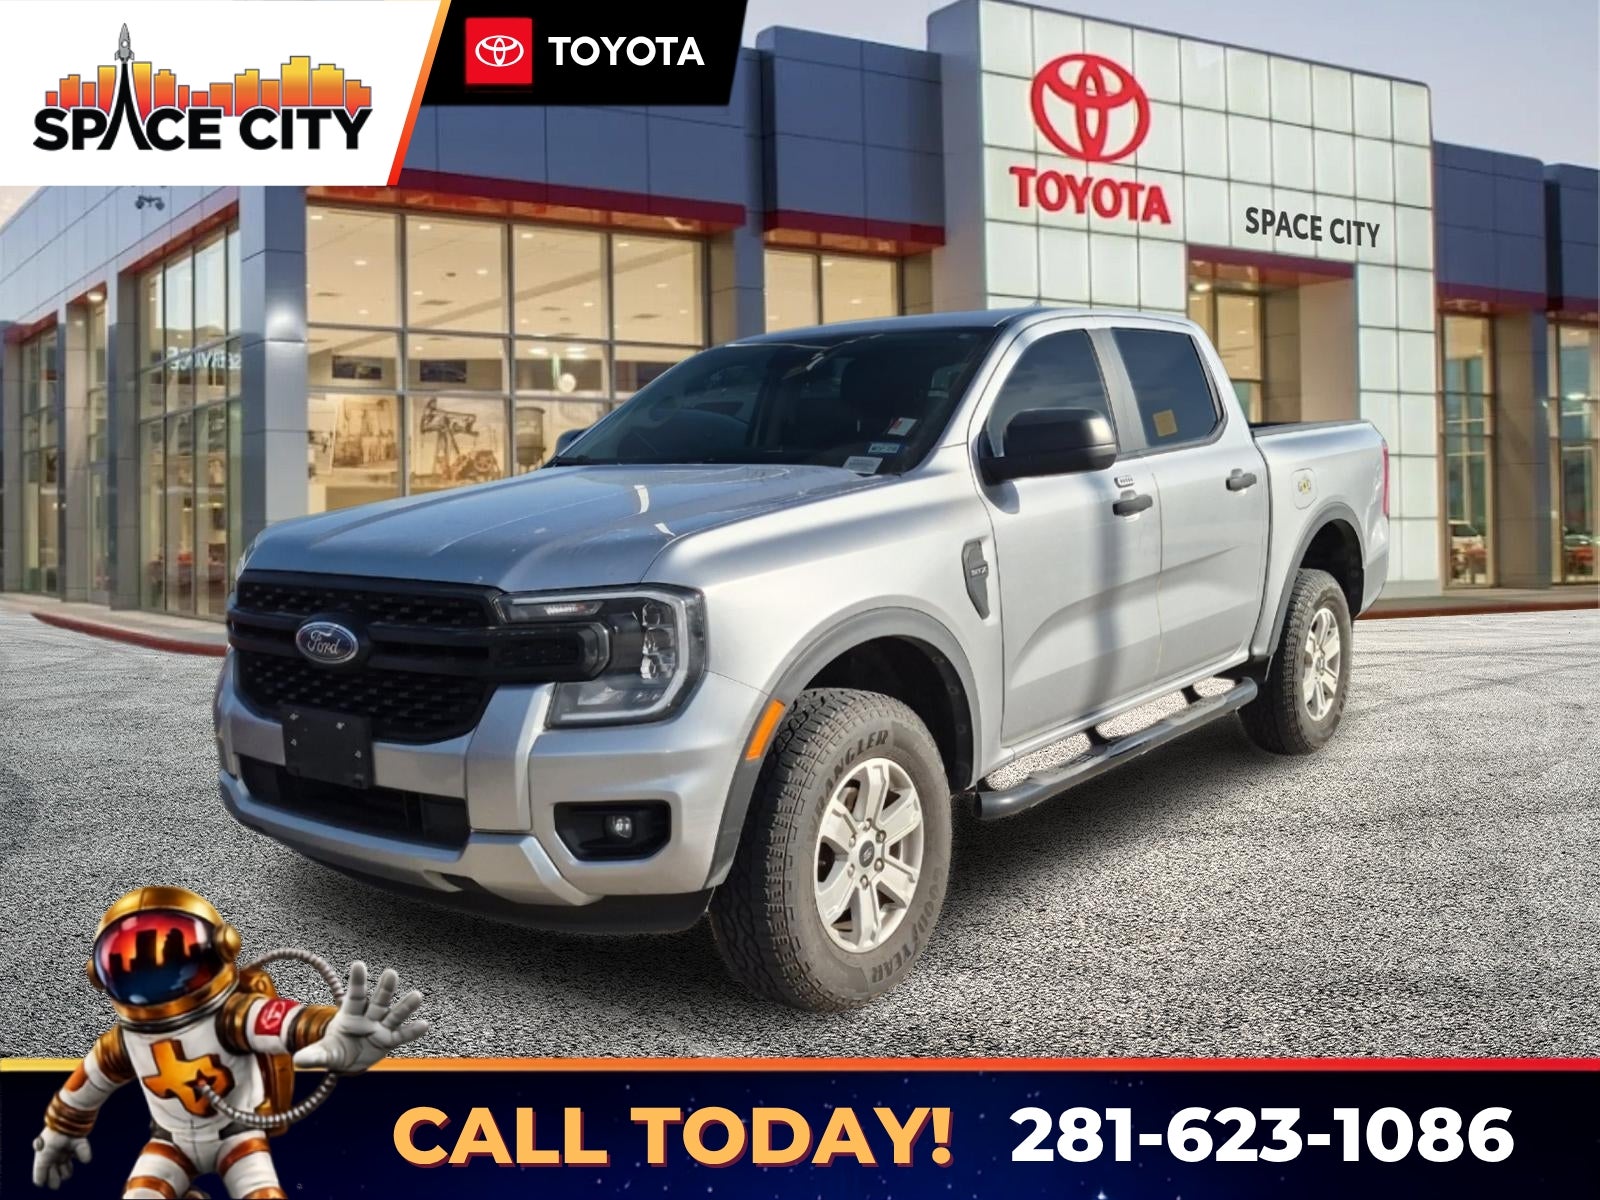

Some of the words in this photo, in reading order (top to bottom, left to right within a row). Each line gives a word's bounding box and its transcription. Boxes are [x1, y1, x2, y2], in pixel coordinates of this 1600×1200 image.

[1010, 165, 1171, 225] TOYOTA
[1245, 206, 1323, 242] SPACE
[1329, 217, 1381, 249] CITY
[307, 630, 342, 655] Ford
